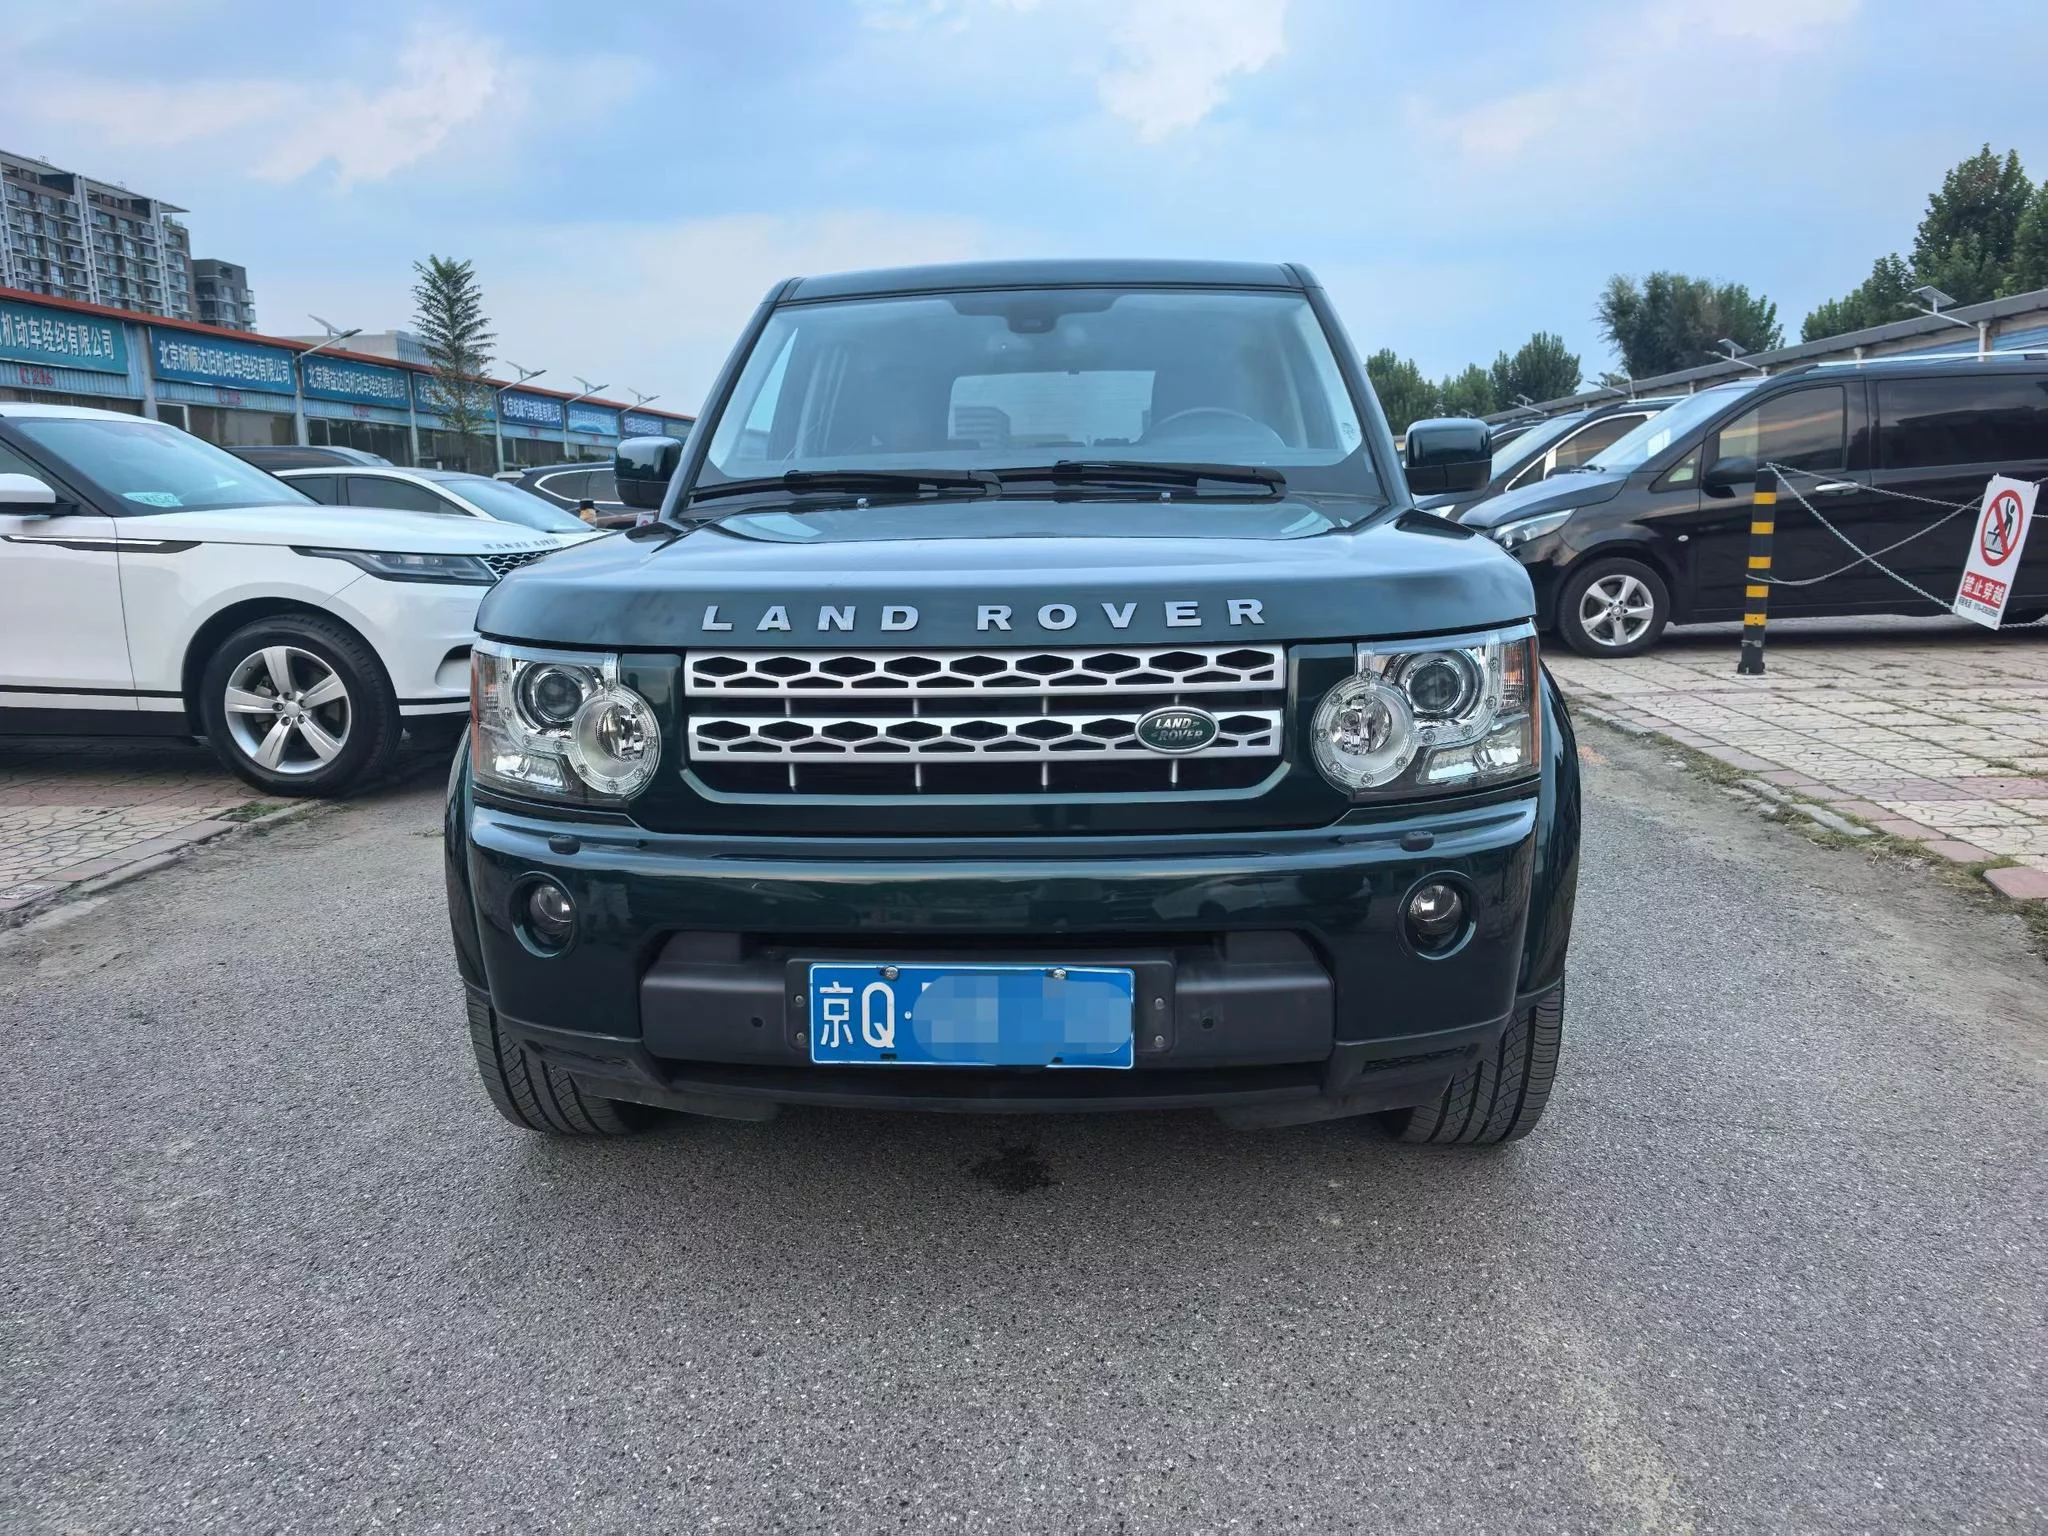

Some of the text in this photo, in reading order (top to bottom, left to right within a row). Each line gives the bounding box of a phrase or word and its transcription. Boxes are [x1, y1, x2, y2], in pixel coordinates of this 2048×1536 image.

[0, 311, 114, 360] 机动车经纪有限公司
[1962, 575, 2005, 604] 禁止穿越
[702, 598, 1266, 632] LAND ROVER
[1155, 717, 1192, 729] LAND
[1158, 729, 1203, 741] ROVER
